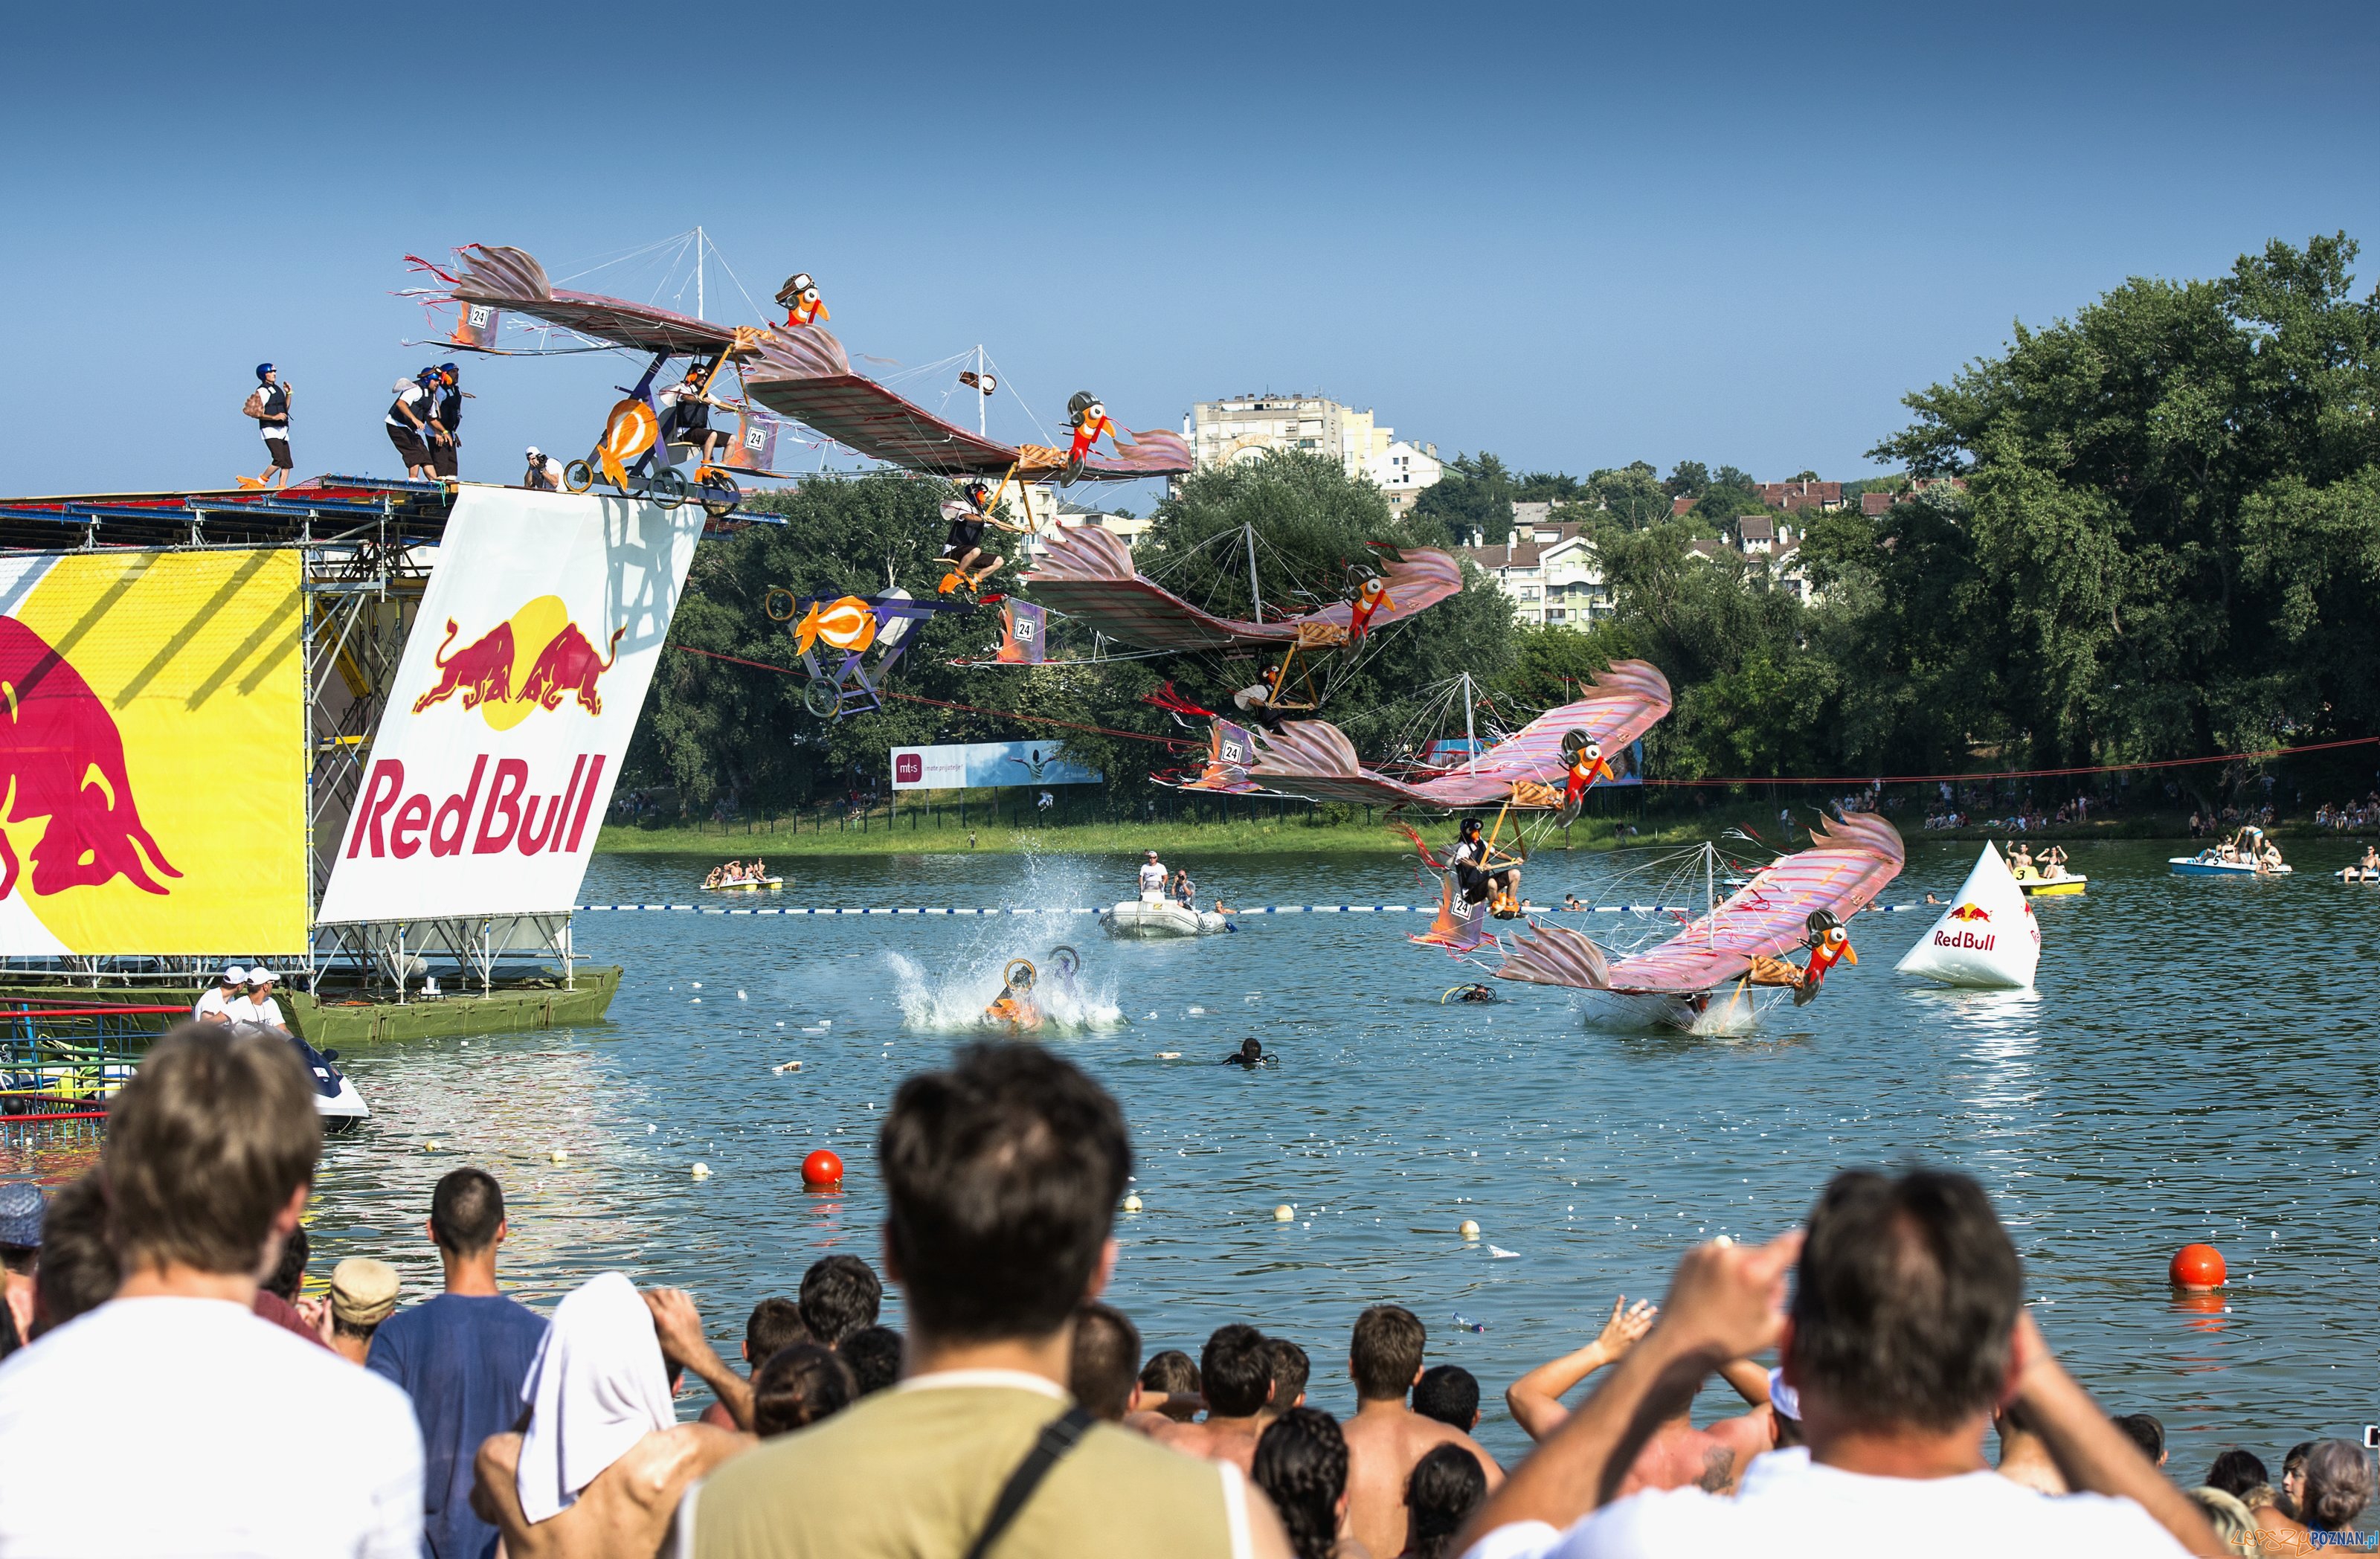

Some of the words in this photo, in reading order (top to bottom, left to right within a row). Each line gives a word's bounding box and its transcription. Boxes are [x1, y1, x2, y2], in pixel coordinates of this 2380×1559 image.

[474, 311, 484, 323] 24
[750, 433, 761, 445] 24
[1019, 624, 1029, 635] 24
[1226, 747, 1237, 759] 24
[347, 753, 489, 859] Red
[472, 753, 606, 857] Bull
[2213, 855, 2220, 865] 5
[2016, 870, 2025, 880] 3
[1456, 900, 1468, 913] 24
[1934, 930, 1962, 948] Red
[1964, 932, 1995, 951] Bull
